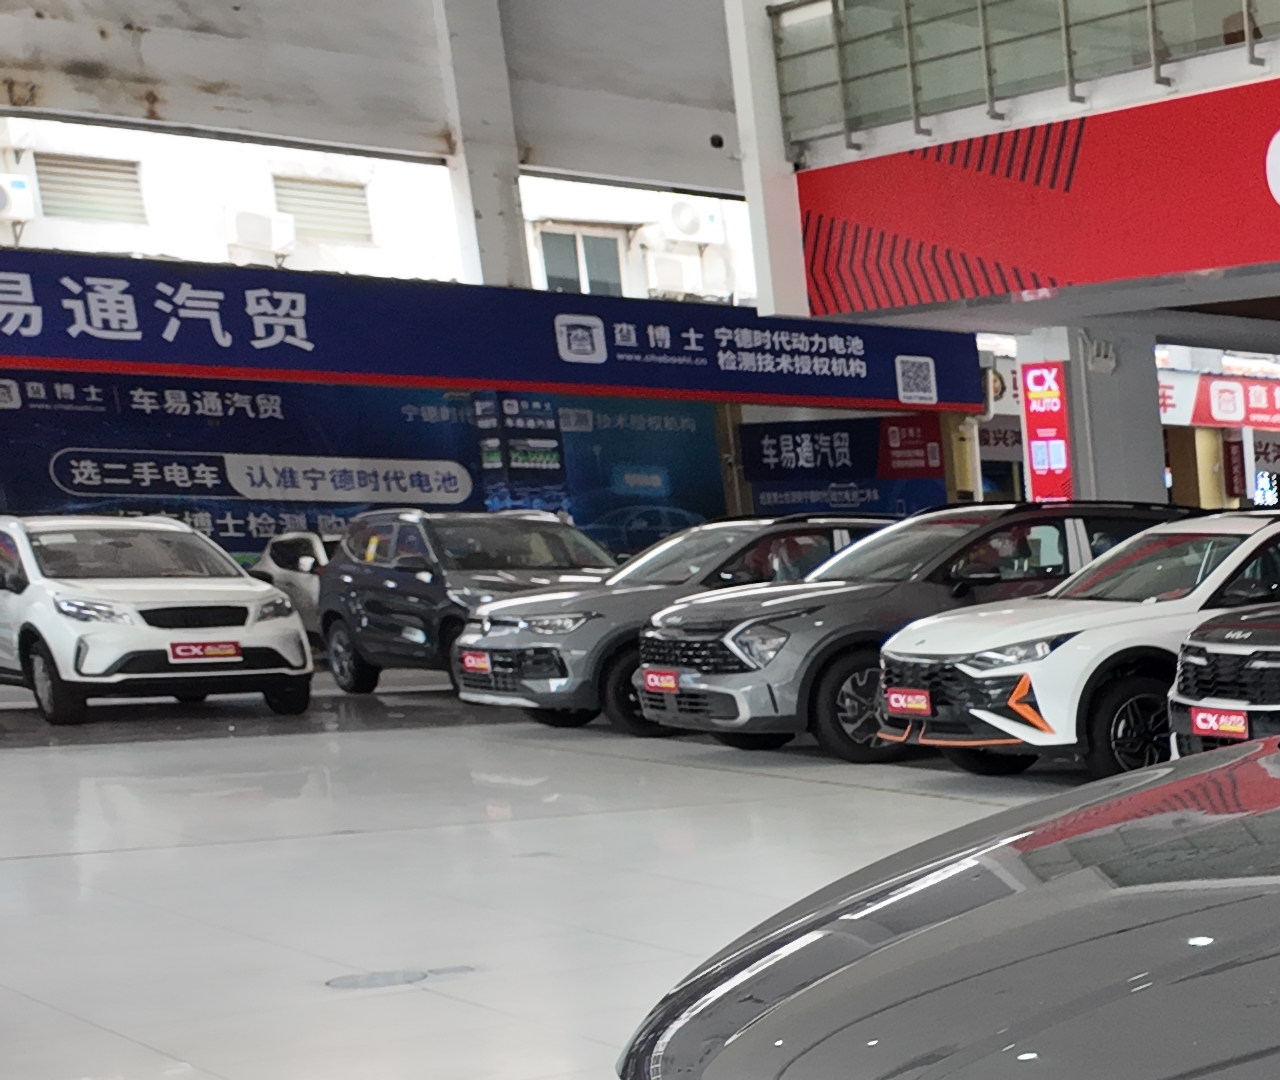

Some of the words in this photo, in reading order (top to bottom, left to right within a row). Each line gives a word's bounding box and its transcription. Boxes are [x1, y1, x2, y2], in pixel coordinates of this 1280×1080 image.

[0, 272, 314, 351] 易通汽贸
[612, 322, 704, 351] 查博士
[714, 326, 864, 355] 宁德时代动力电池
[717, 350, 867, 378] 检测技术授权机构
[1027, 368, 1059, 391] CX
[129, 387, 284, 420] 车易通汽贸
[1030, 398, 1061, 412] AUTO
[760, 431, 852, 470] 车易通汽贸
[69, 459, 221, 488] 选二手电车
[246, 465, 460, 494] 认准宁德时代电池
[175, 645, 204, 656] CX
[1195, 712, 1219, 731] CX
